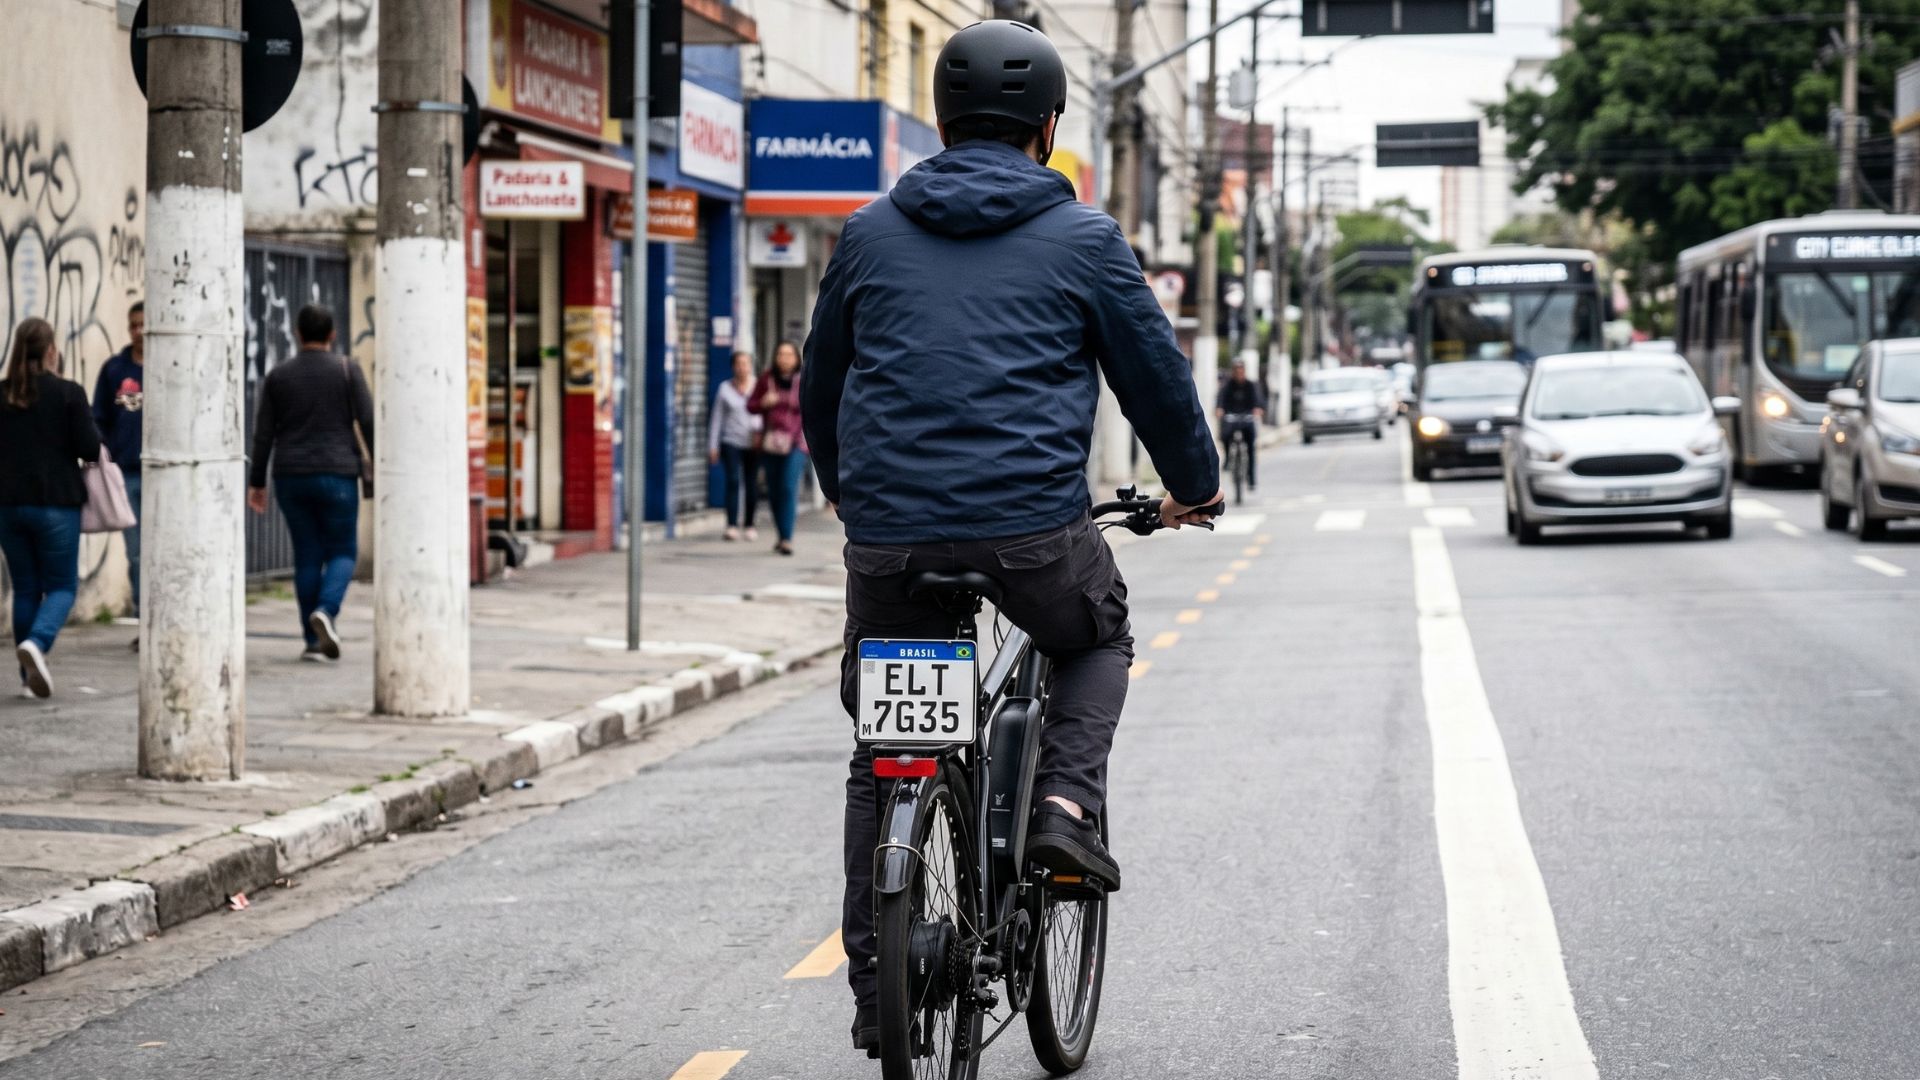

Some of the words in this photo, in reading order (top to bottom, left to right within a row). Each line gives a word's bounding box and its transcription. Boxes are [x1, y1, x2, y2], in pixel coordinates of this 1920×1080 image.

[755, 132, 873, 158] FARMÁCIA
[900, 648, 937, 658] BRASIL
[885, 663, 949, 696] ELT
[862, 723, 872, 736] M
[874, 700, 959, 733] 7G35
